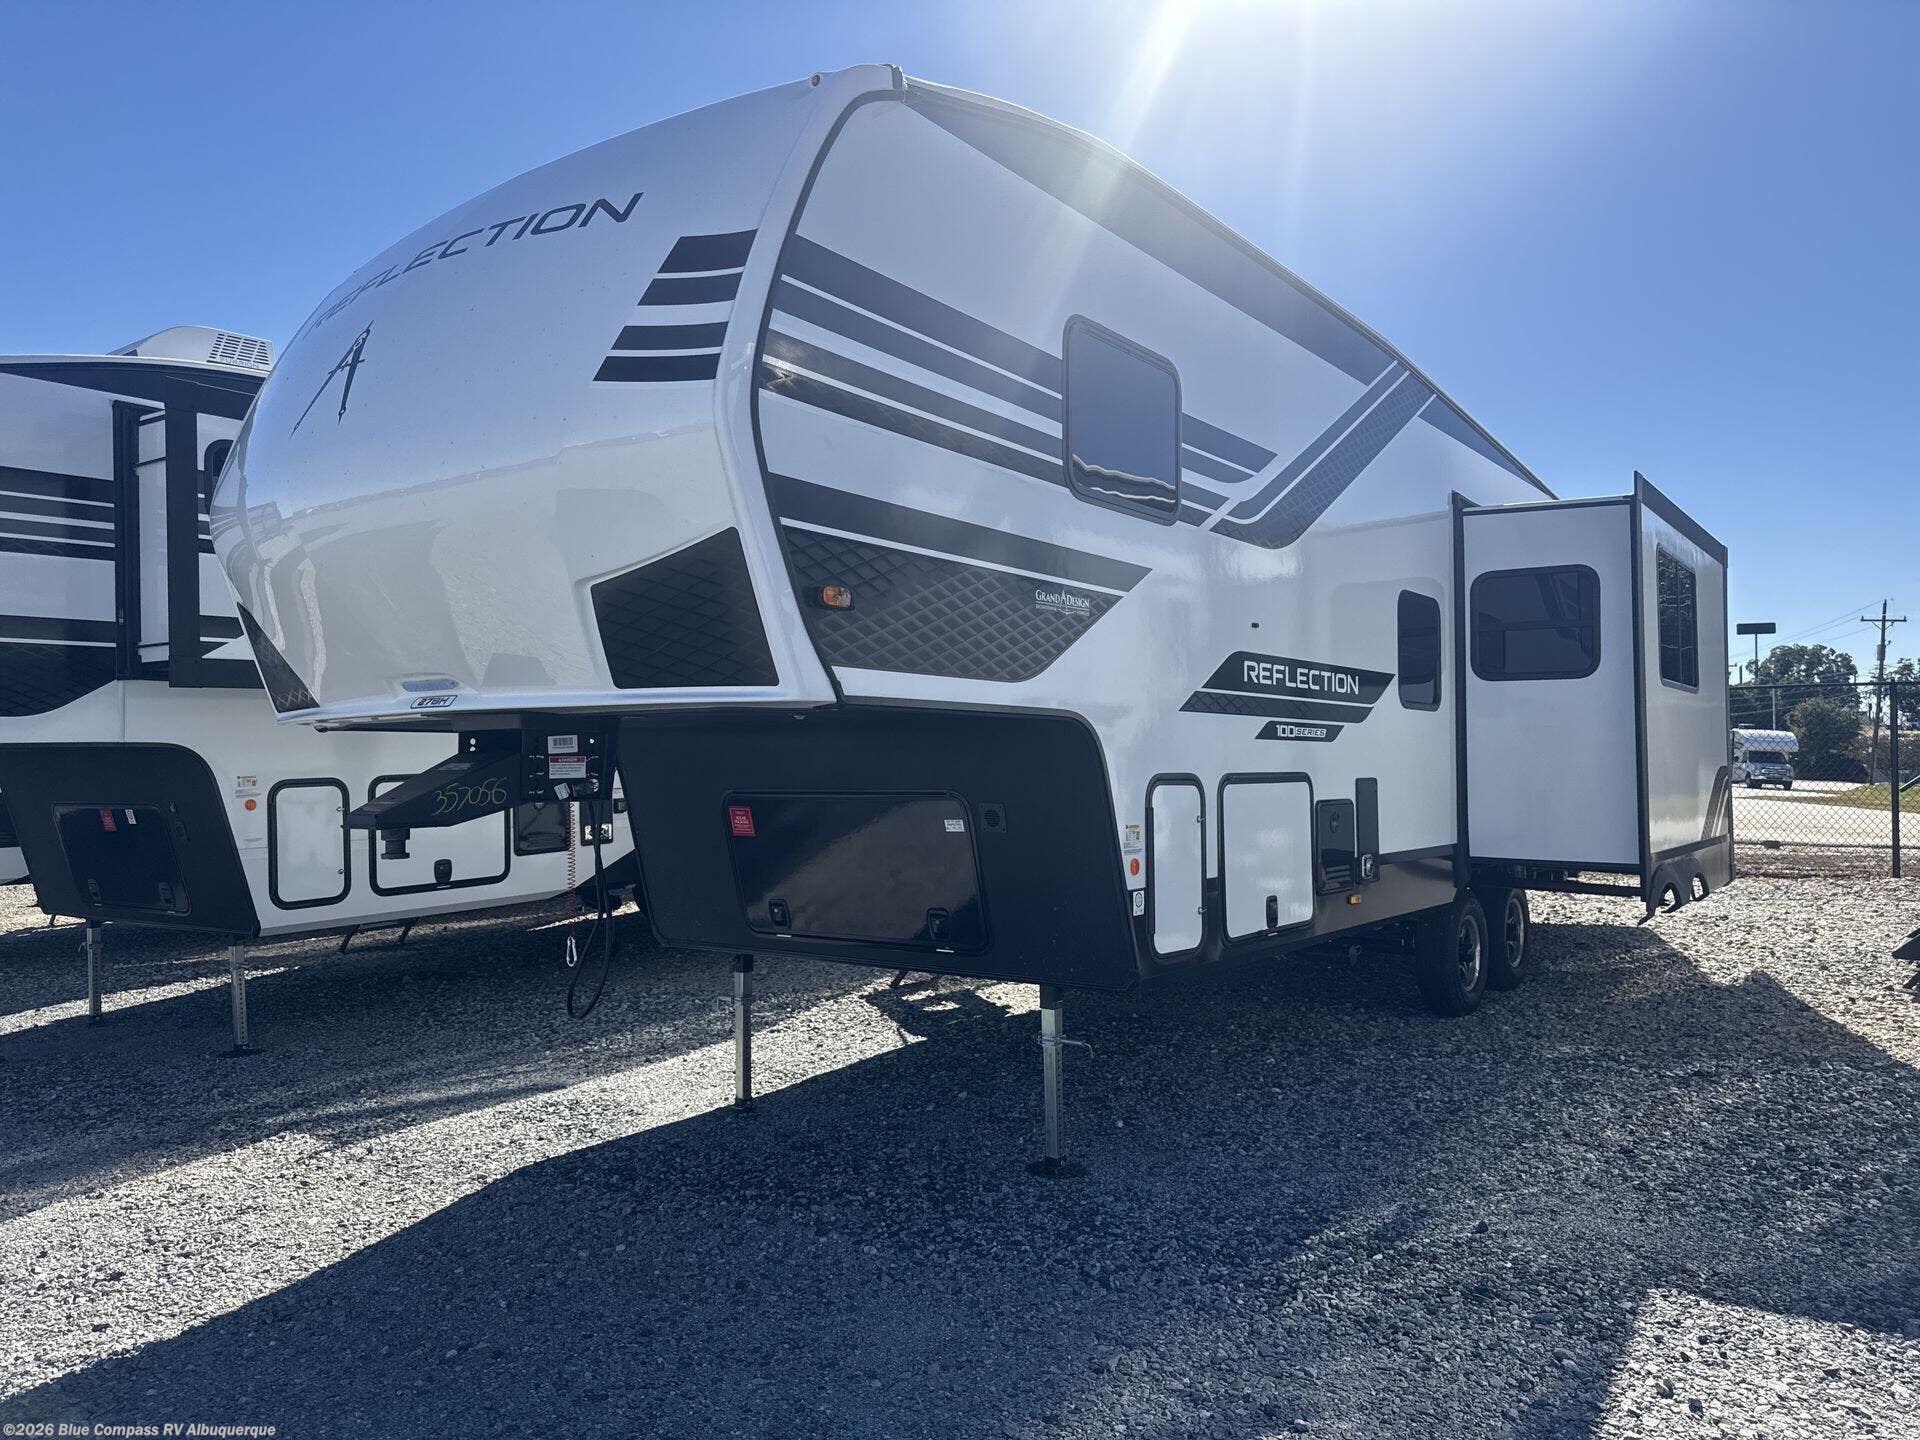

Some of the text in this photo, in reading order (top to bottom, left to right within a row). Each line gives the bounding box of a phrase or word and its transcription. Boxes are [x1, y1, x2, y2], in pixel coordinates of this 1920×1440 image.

[1243, 660, 1359, 695] REFLECTION
[1276, 724, 1326, 738] 100 SERIES
[432, 776, 508, 816] 357056
